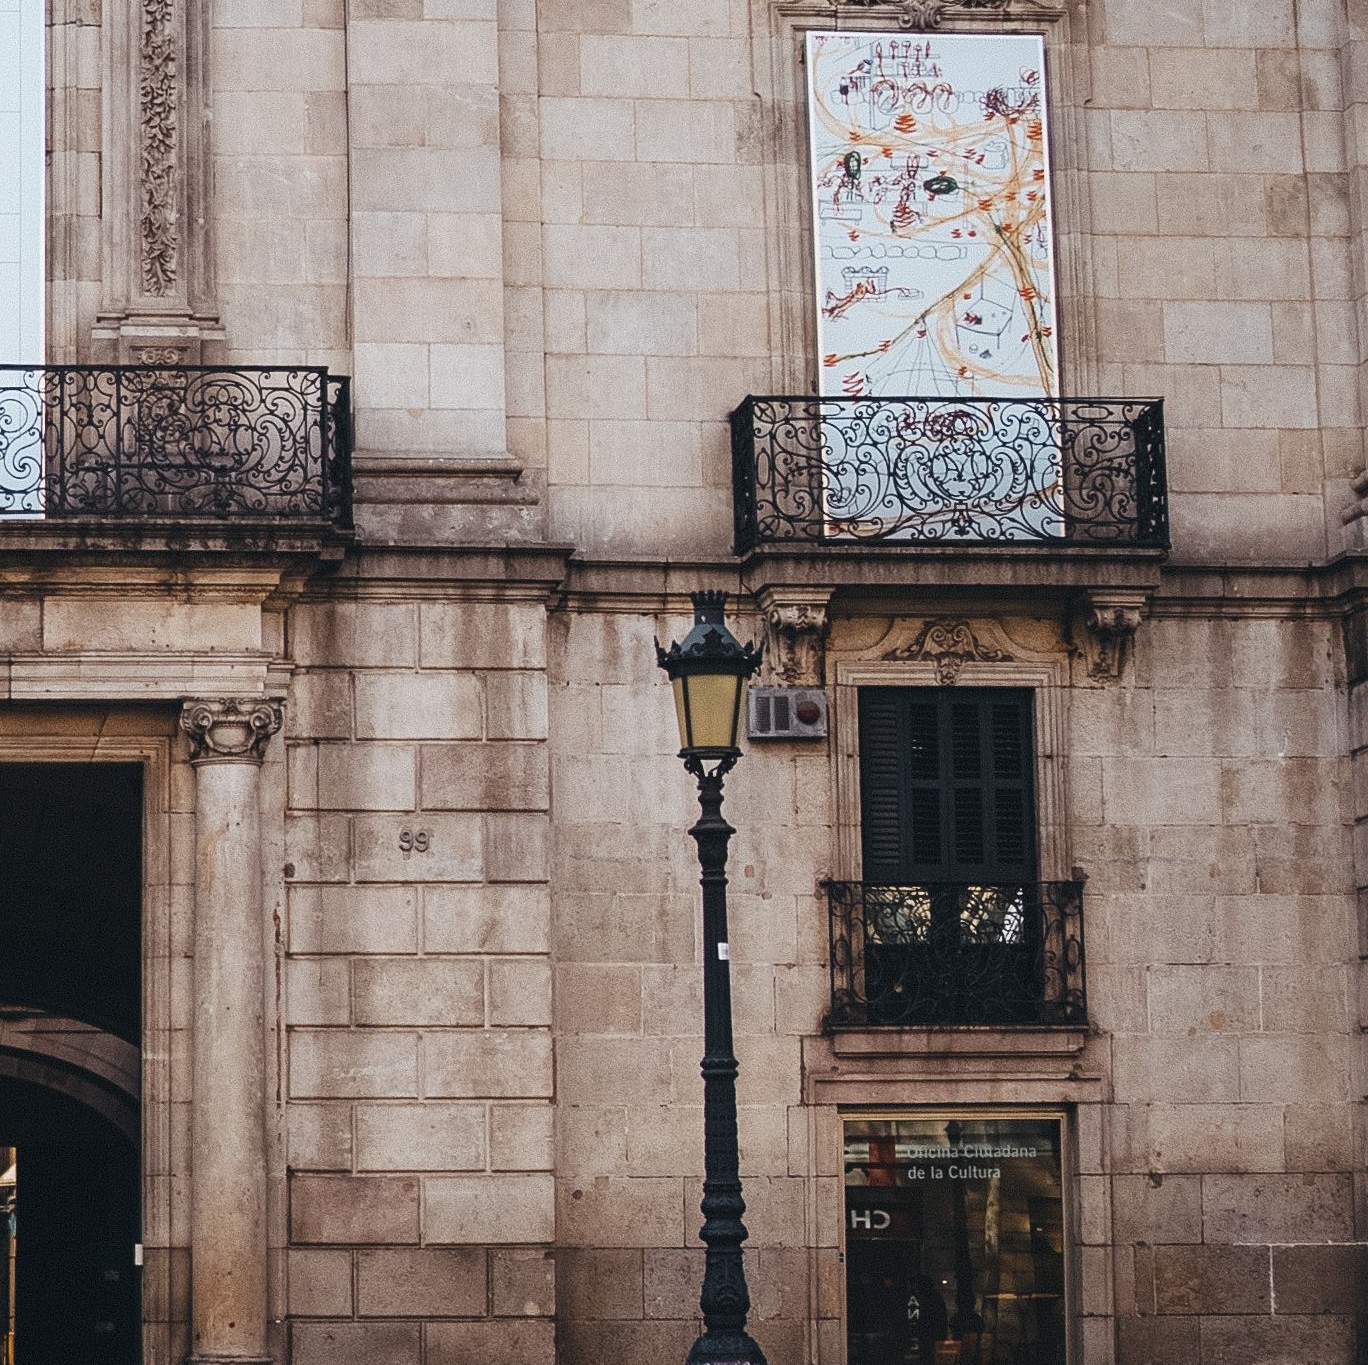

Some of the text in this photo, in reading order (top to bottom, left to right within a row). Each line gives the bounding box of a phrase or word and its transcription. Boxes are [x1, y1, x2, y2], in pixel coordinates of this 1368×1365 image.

[399, 830, 429, 852] 99
[908, 1166, 1000, 1179] de la Cultura
